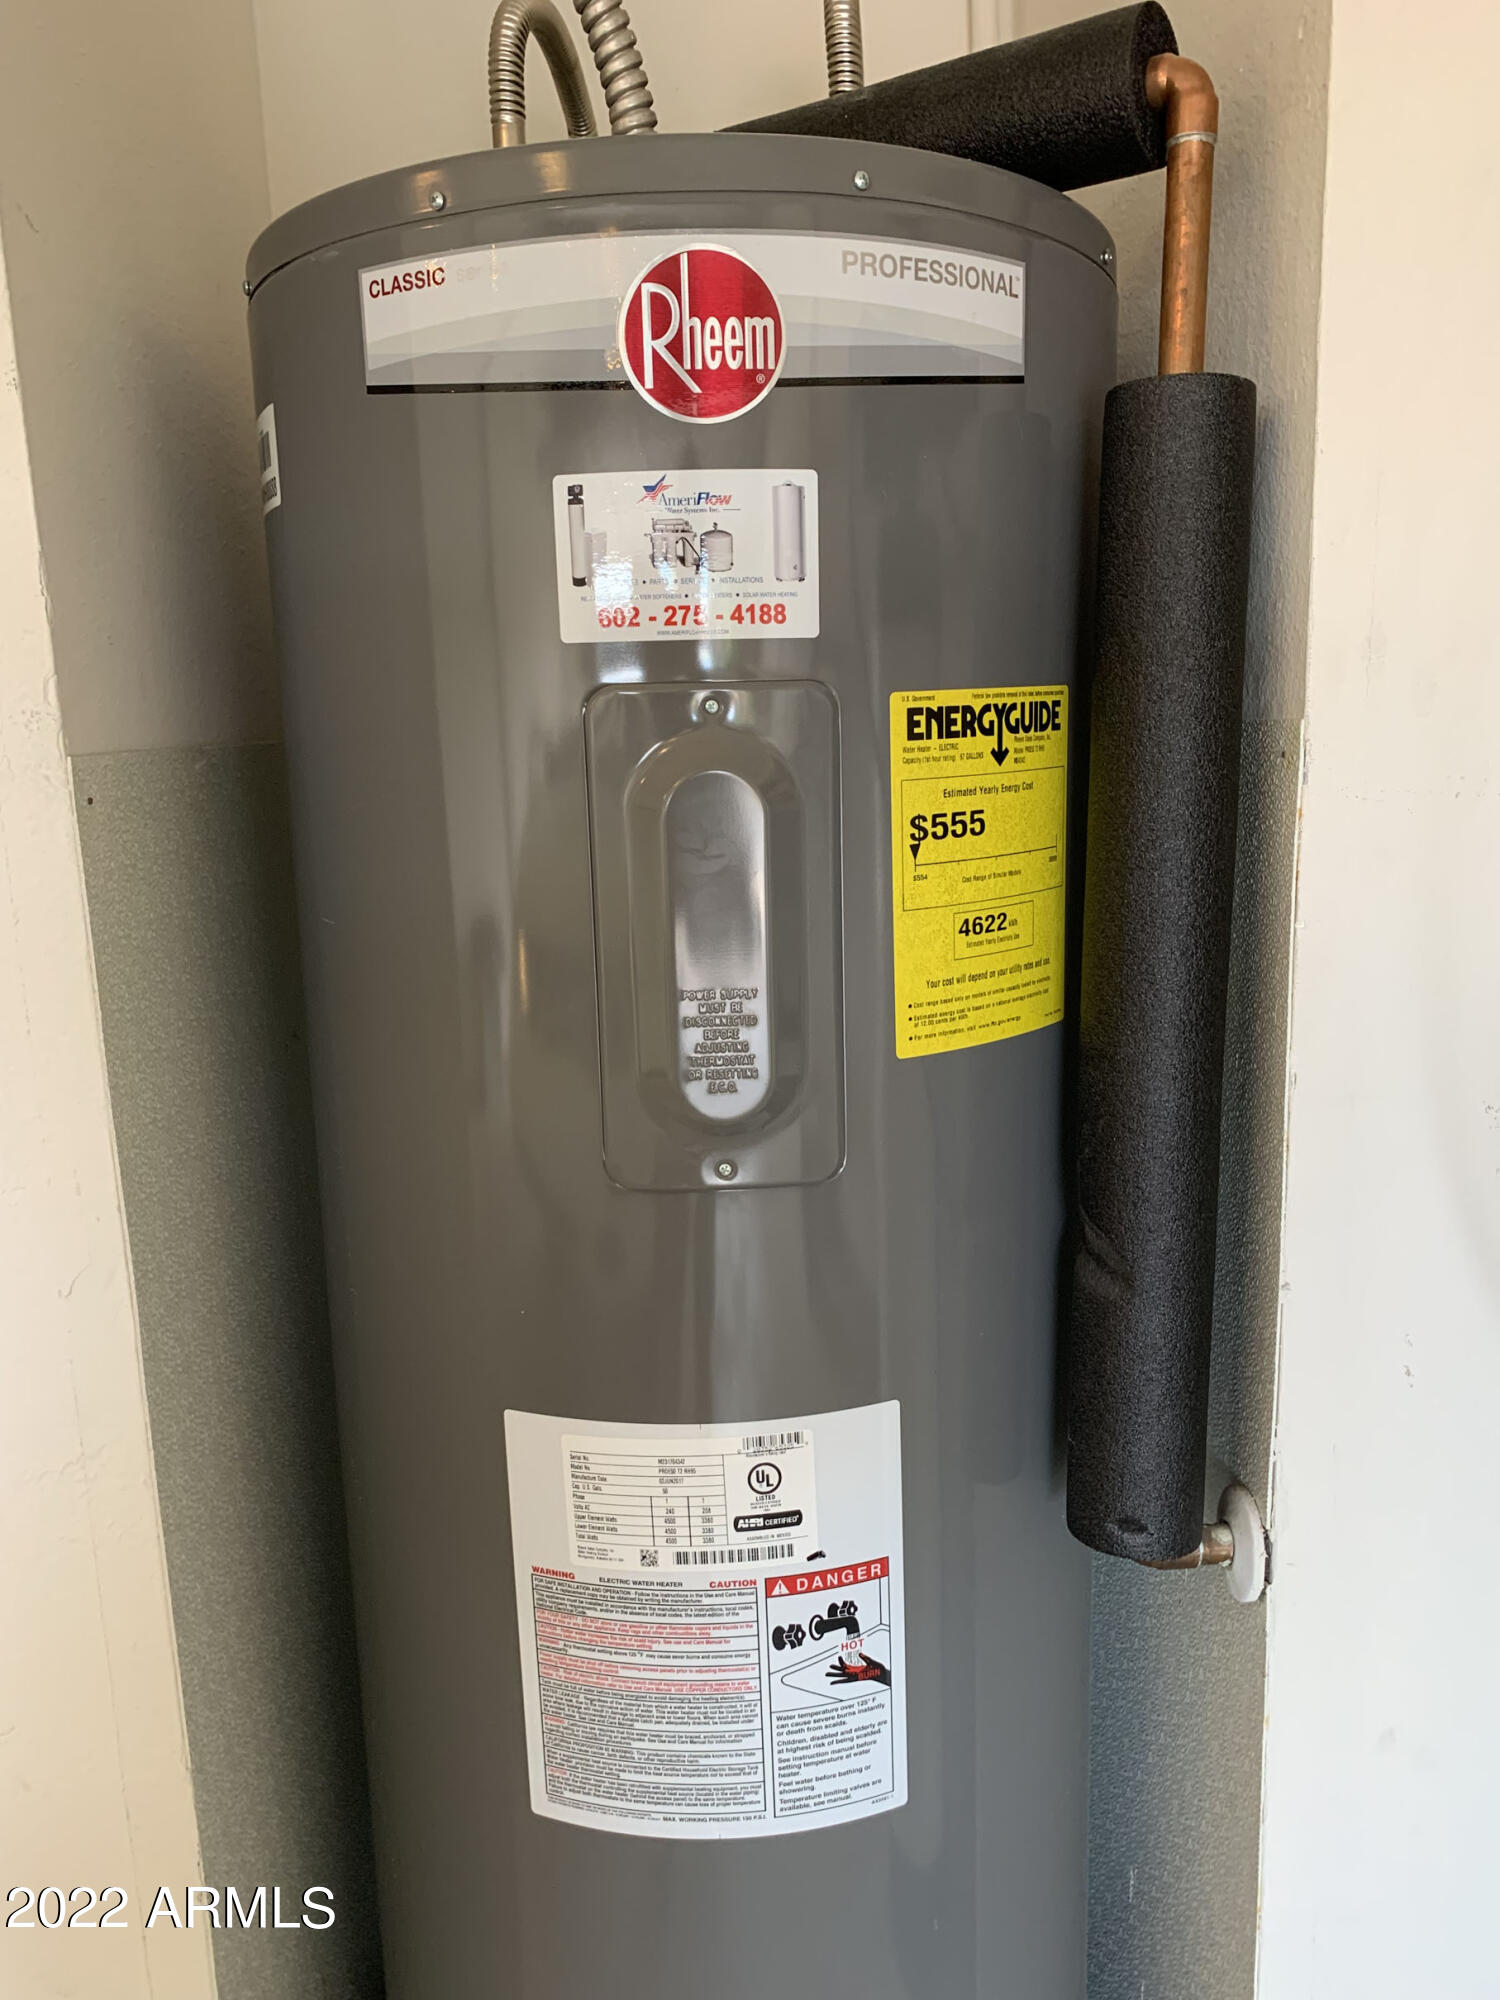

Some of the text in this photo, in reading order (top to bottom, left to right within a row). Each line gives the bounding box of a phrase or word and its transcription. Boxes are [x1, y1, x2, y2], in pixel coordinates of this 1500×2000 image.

[369, 267, 445, 298] CLASSIC
[641, 253, 776, 394] Rheem
[660, 491, 732, 506] AmeriFlow
[598, 606, 640, 628] 602
[664, 604, 705, 626] 275
[730, 603, 787, 625] 4188
[907, 700, 1062, 742] ENERGYGUIDE
[943, 780, 1034, 798] Estimated Yearly Energy Cost
[910, 809, 986, 843] $555
[958, 912, 1008, 937] 4622
[926, 979, 941, 989] Your
[942, 976, 955, 987] cost
[956, 974, 967, 984] will
[968, 970, 989, 983] depend
[990, 970, 996, 979] on
[680, 988, 758, 1001] POWER SUPPLY
[698, 1001, 743, 1014] MUST BE
[682, 1015, 758, 1028] DISCONNECTED
[703, 1028, 740, 1040] BEFORE
[694, 1041, 749, 1054] ADJUSTING
[687, 1054, 756, 1067] THERMOSTAT
[688, 1068, 759, 1080] OR RESETTING
[756, 1469, 775, 1488] UL
[756, 1494, 776, 1502] LISTED
[664, 1527, 677, 1535] 4500
[531, 1565, 576, 1580] WARNING
[796, 1563, 882, 1592] DANGER
[599, 1577, 683, 1588] ELECTRIC WATER HEATER
[709, 1578, 758, 1589] CAUTION
[841, 1638, 865, 1651] HOT
[776, 1713, 796, 1722] Water
[797, 1706, 838, 1720] temperature
[840, 1704, 855, 1712] over
[776, 1702, 885, 1731] can cause severe burns instantly
[777, 1719, 888, 1747] Children, disabled and elderly are
[785, 1727, 805, 1737] death
[807, 1724, 823, 1733] from
[778, 1739, 878, 1764] See instruction manual before
[786, 1743, 811, 1755] highest
[813, 1740, 826, 1749] risk
[827, 1738, 835, 1746] of
[835, 1735, 854, 1745] being
[778, 1763, 802, 1772] setting
[803, 1755, 844, 1768] temperature
[853, 1748, 871, 1758] water
[779, 1763, 872, 1788] Feel water before bathing or
[780, 1778, 883, 1805] Temperature limiting valves are
[813, 1799, 825, 1807] see
